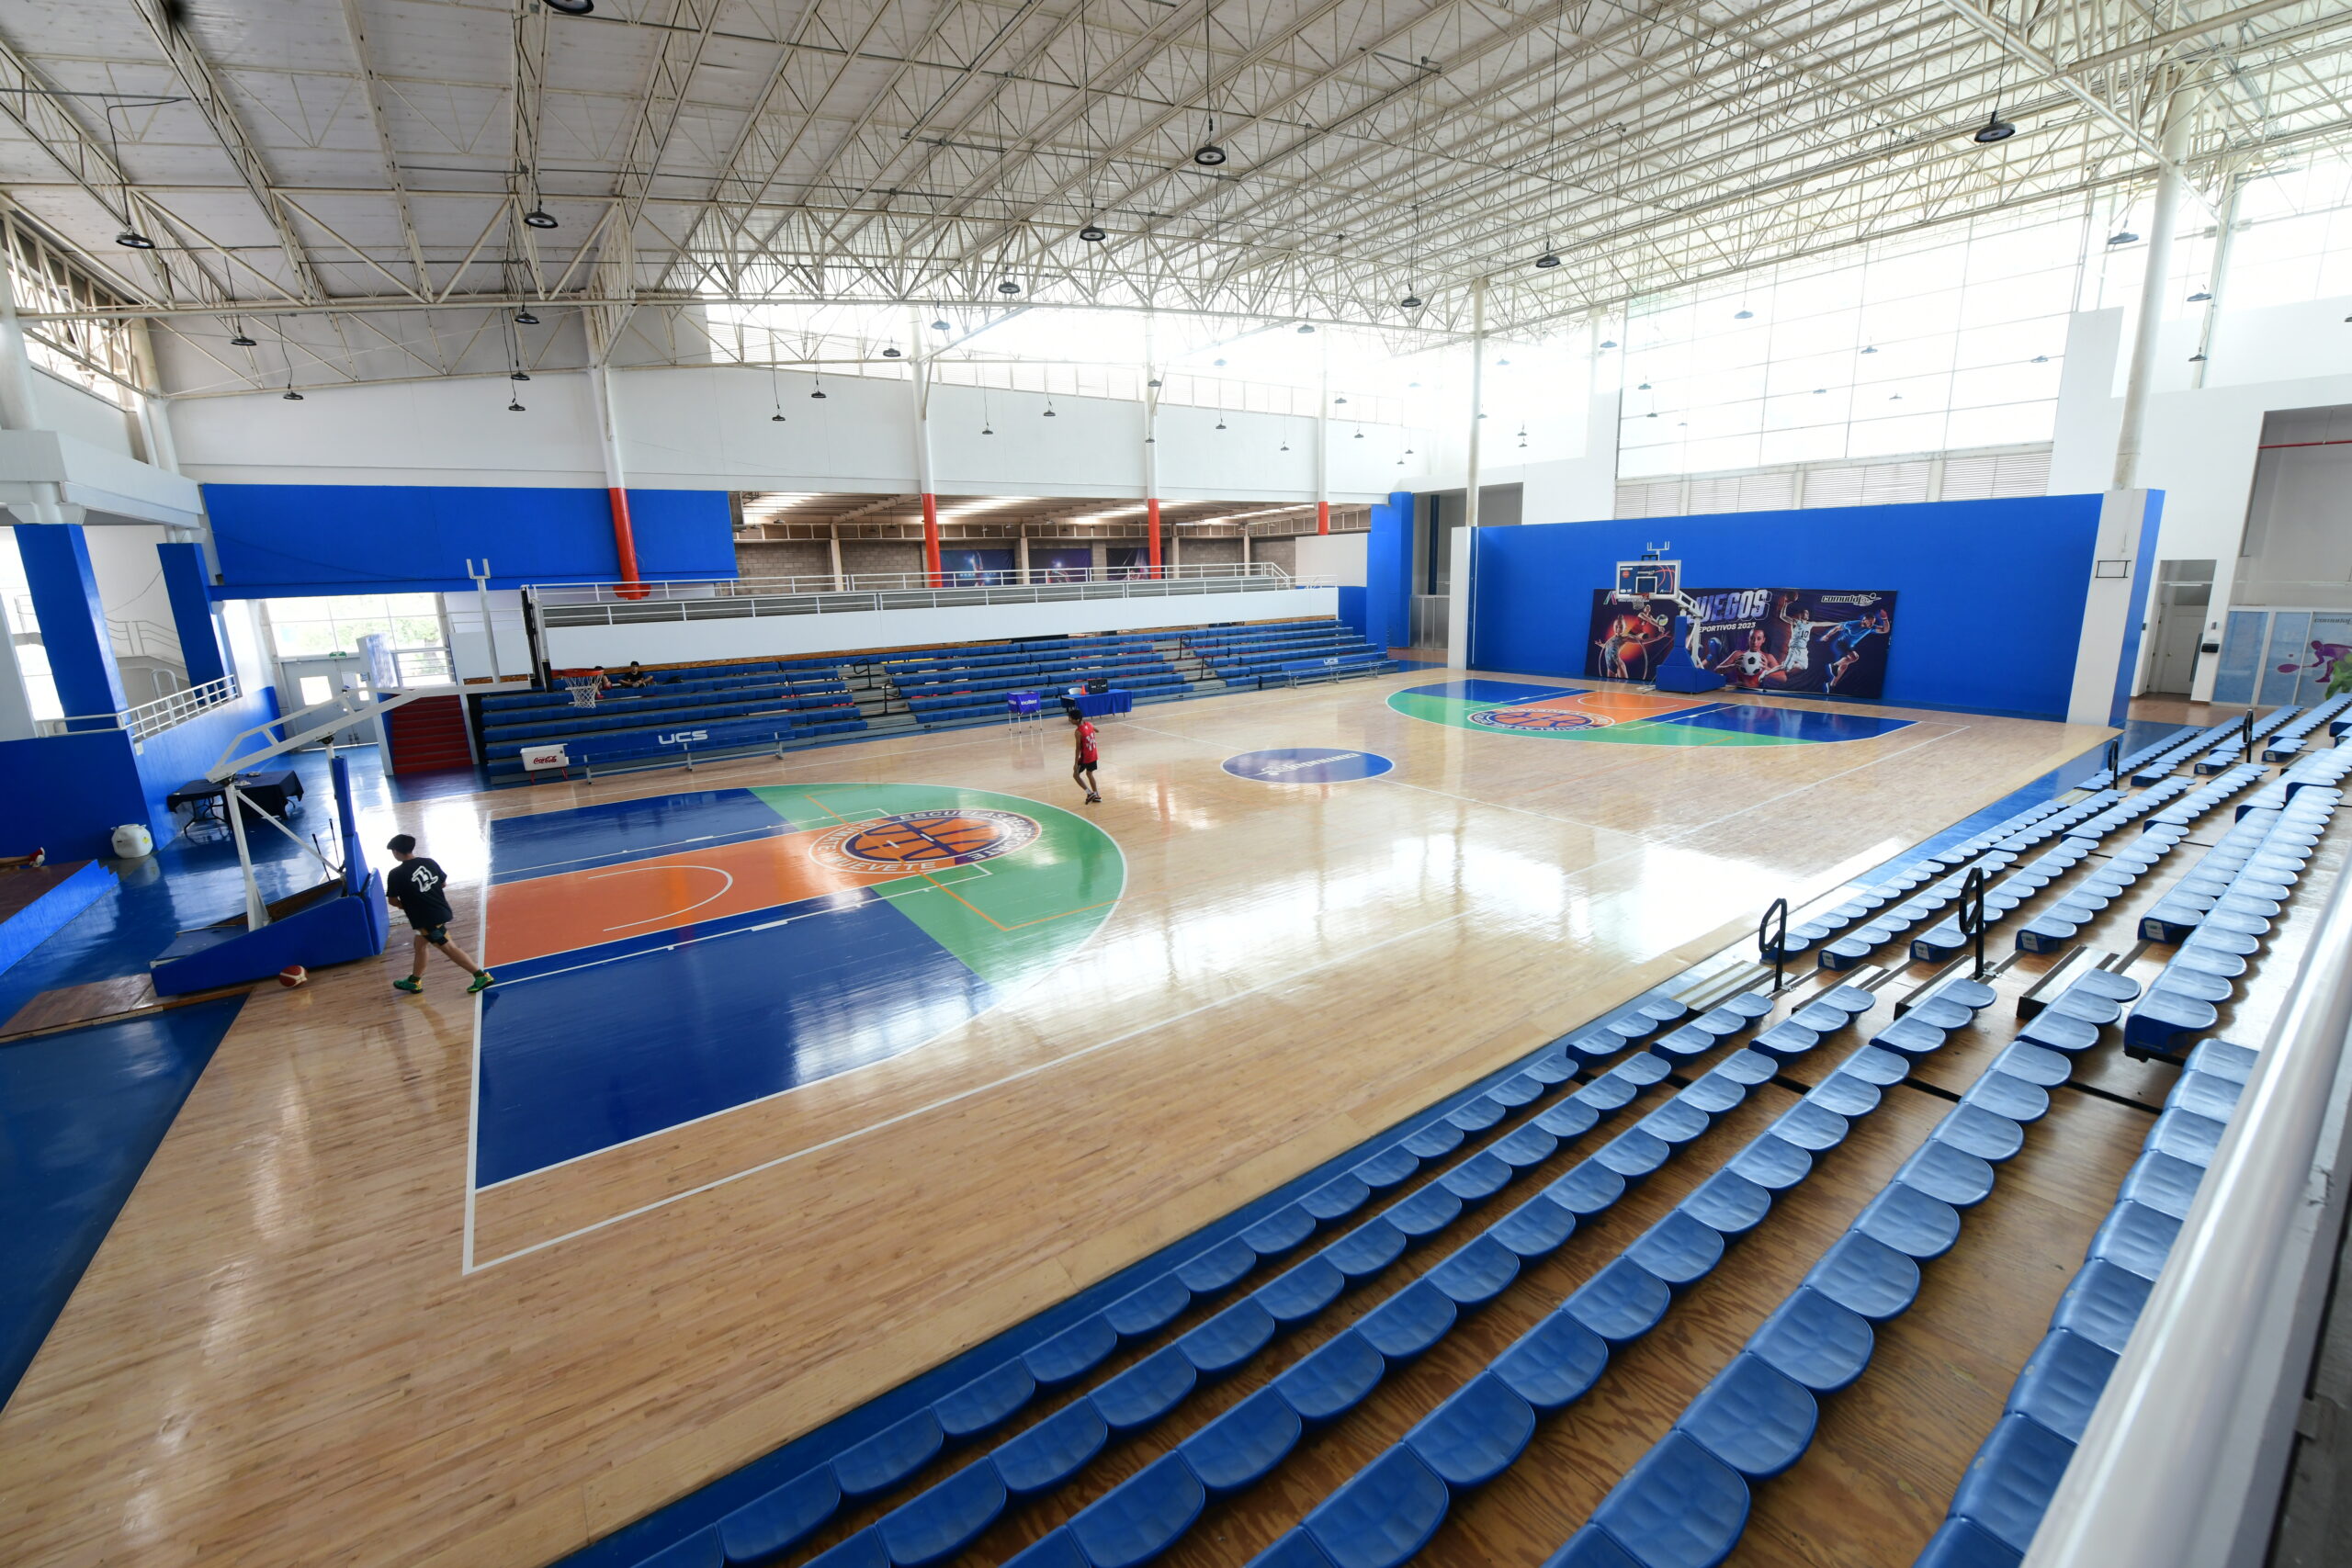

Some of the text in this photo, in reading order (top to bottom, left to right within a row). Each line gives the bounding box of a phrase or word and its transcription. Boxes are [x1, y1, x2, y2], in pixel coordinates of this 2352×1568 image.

[1699, 622, 1757, 633] EPORTIVOS 2023
[1800, 630, 1809, 638] 10
[658, 729, 708, 745] UCS
[899, 810, 1008, 820] ESCUELAS
[967, 827, 1033, 861] DEPORTE
[822, 855, 936, 872] MUEVETE
